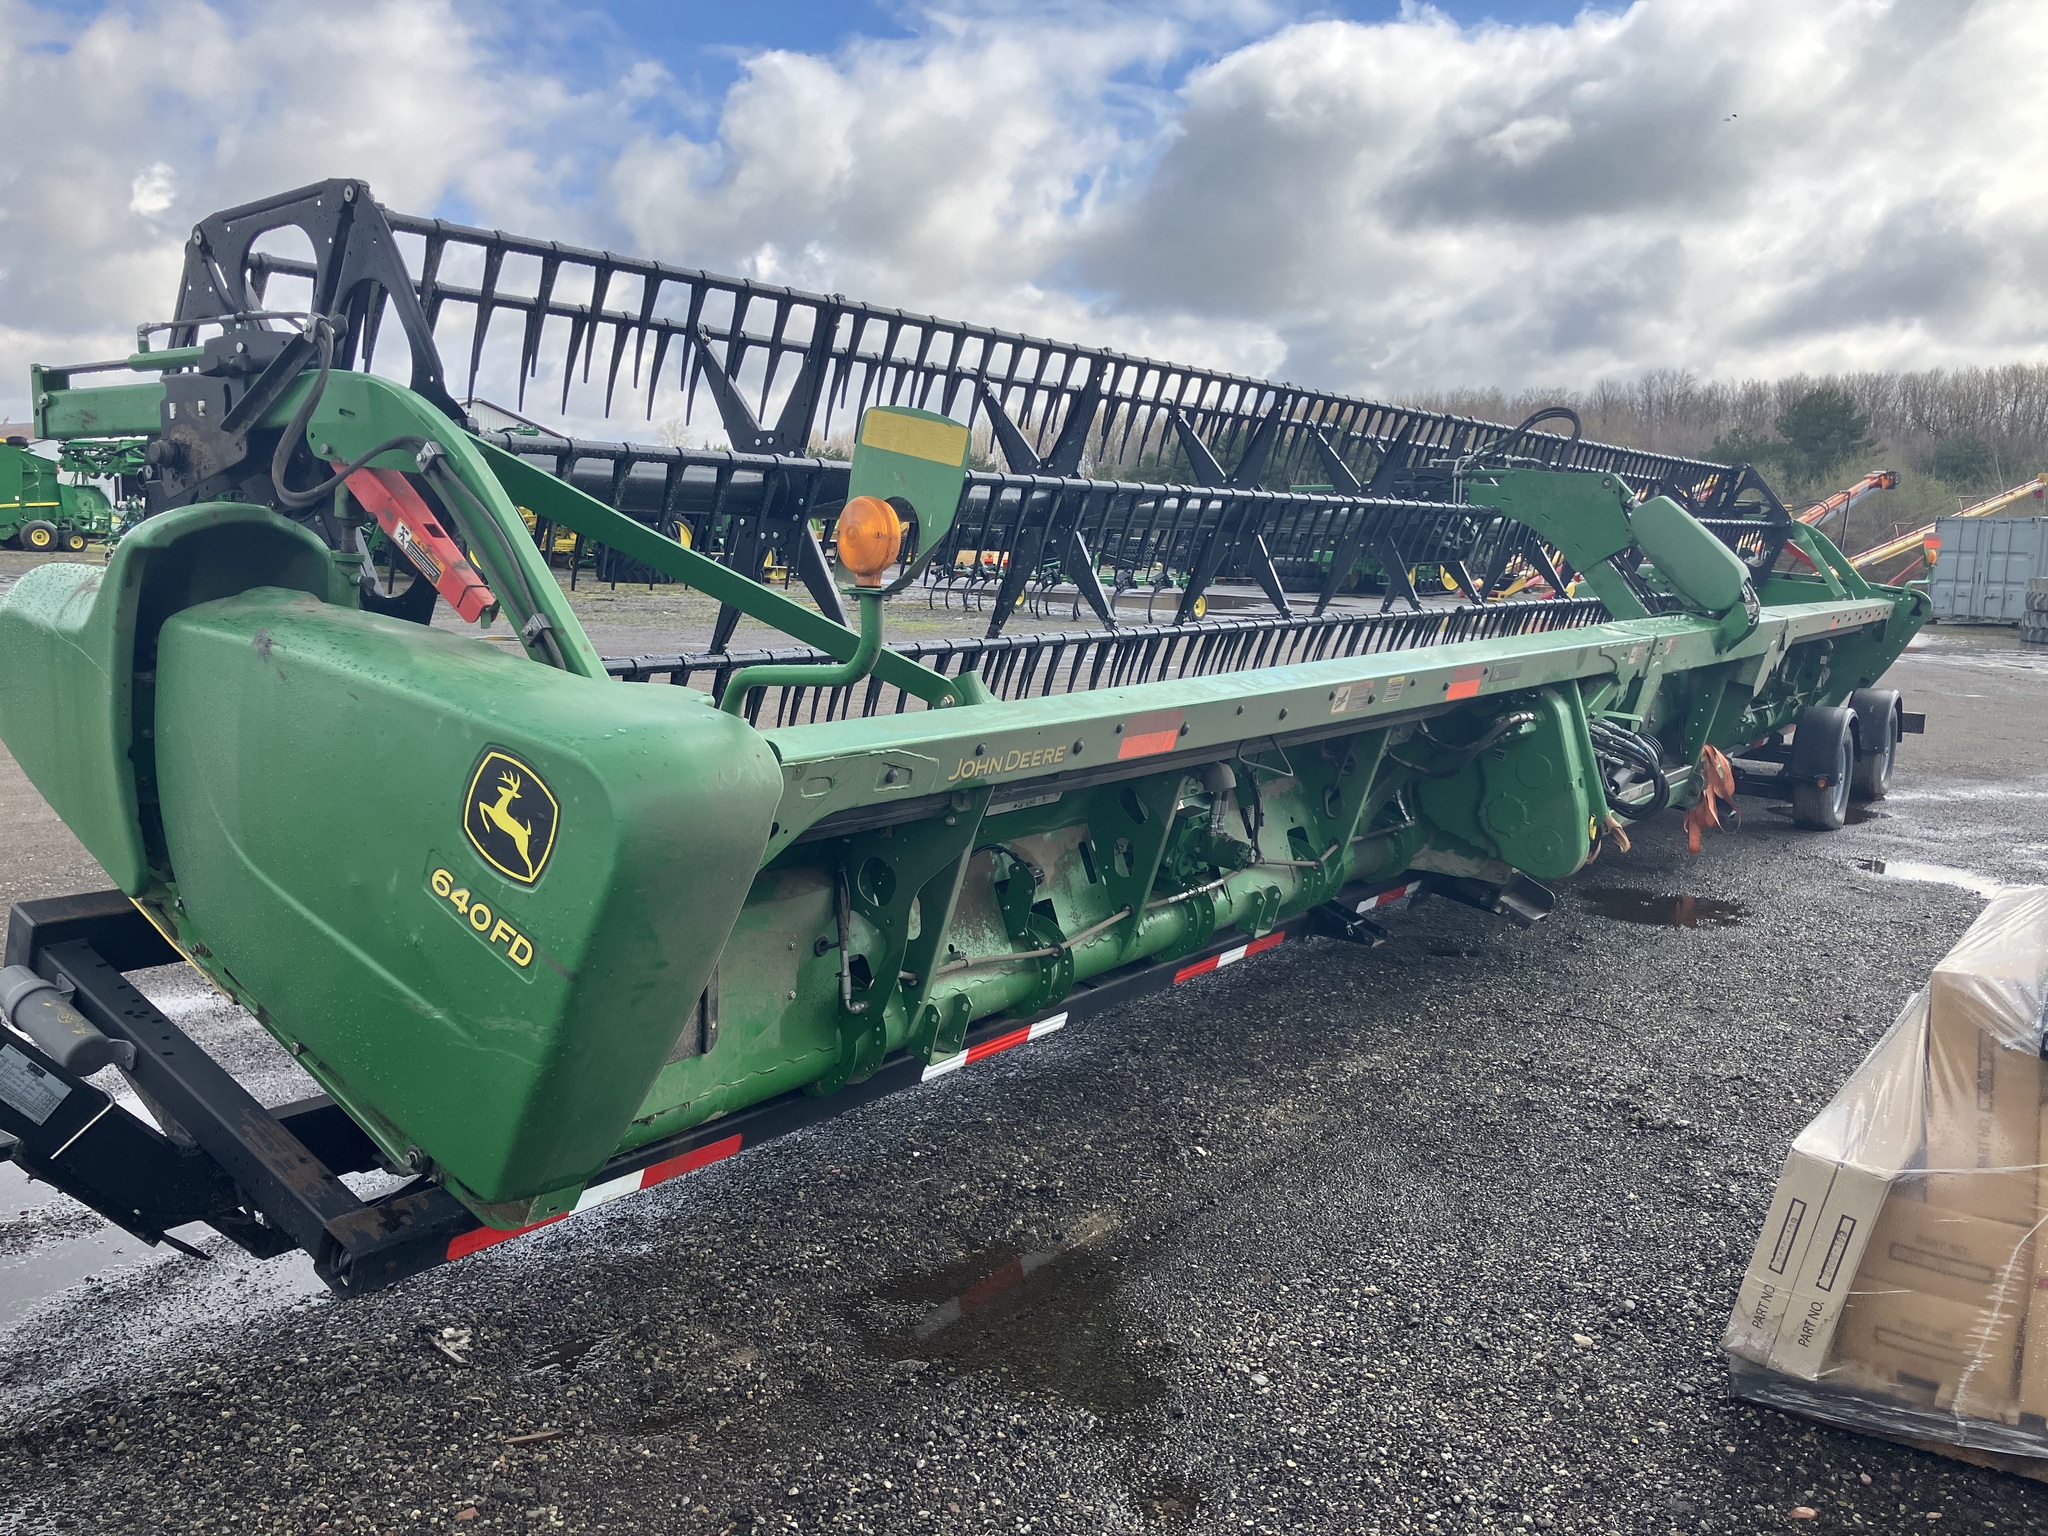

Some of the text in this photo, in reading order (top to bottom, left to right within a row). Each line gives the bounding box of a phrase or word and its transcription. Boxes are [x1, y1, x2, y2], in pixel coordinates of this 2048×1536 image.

[947, 745, 1067, 781] JOHN DEERE
[1752, 1300, 1770, 1329] PART
[1797, 1301, 1826, 1348] PART NO.
